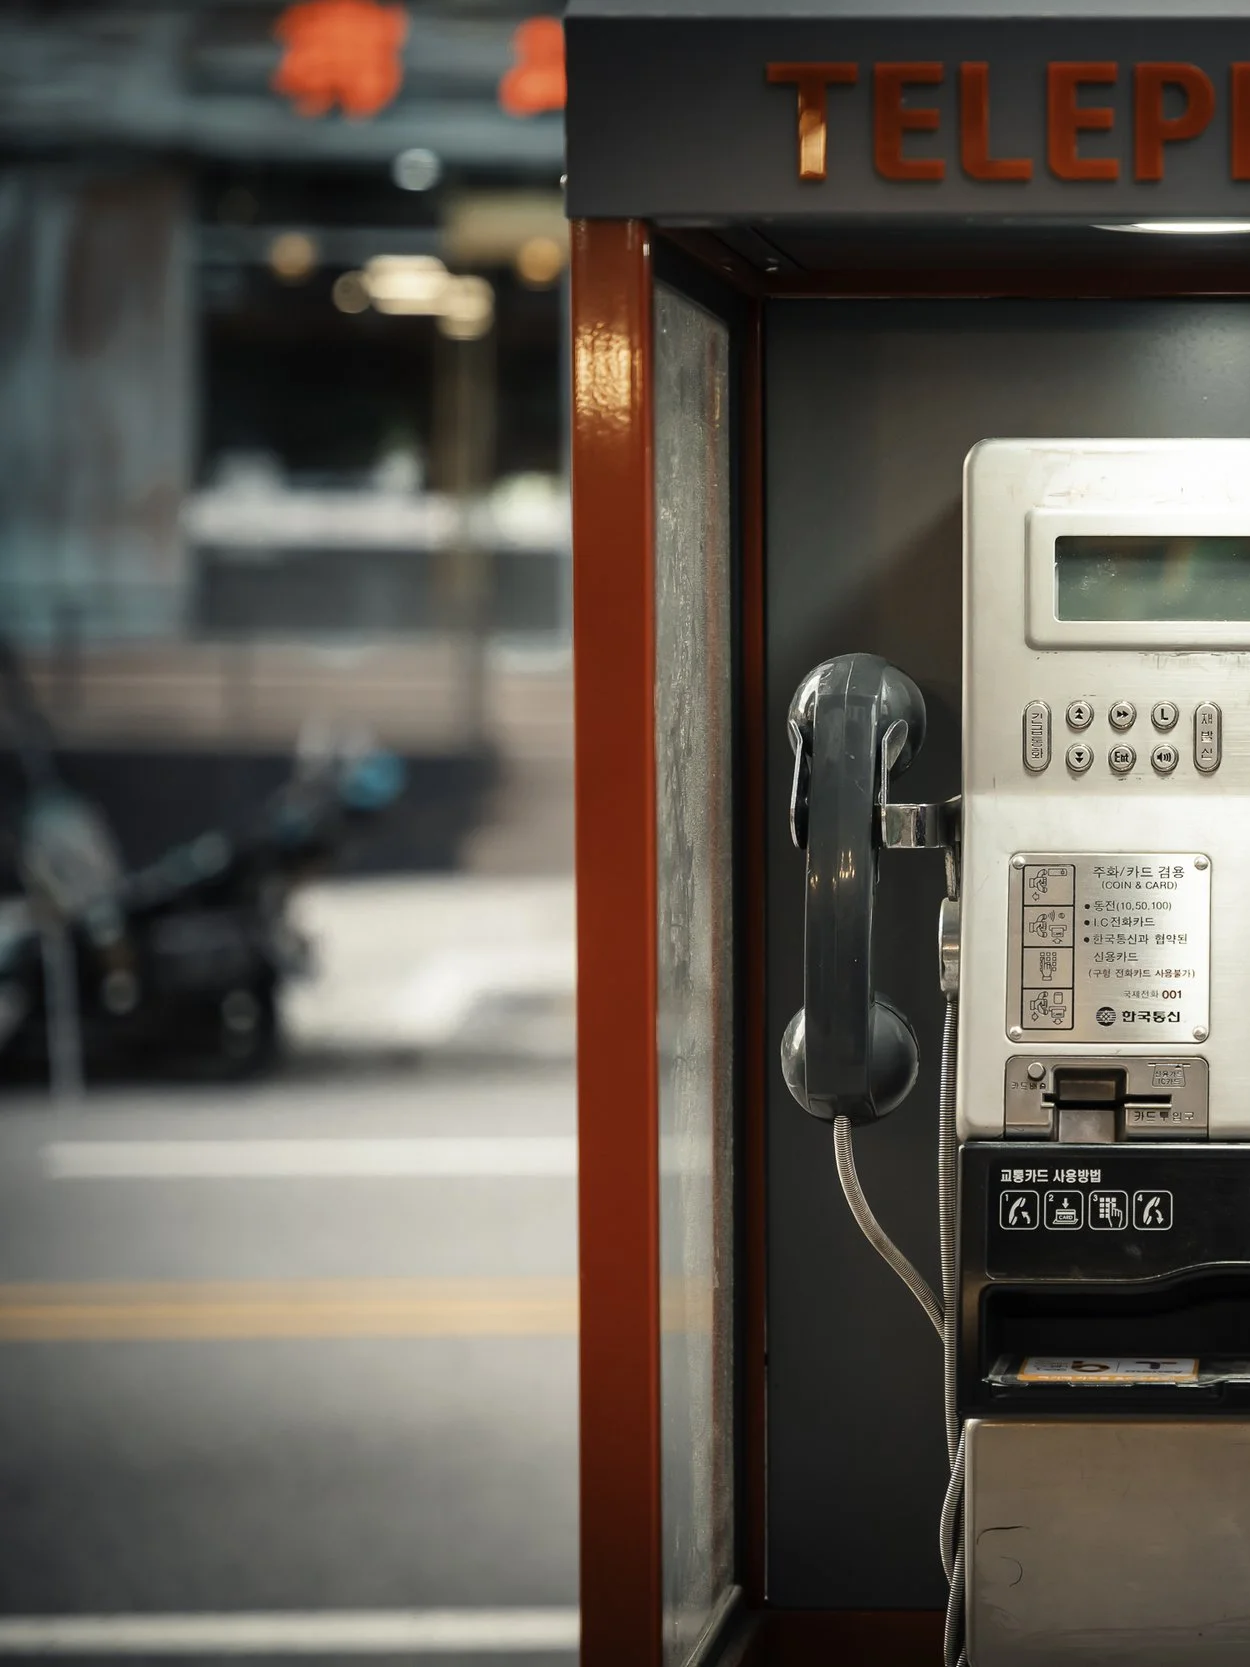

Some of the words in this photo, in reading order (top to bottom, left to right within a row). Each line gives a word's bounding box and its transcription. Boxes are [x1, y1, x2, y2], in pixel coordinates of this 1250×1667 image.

[1160, 708, 1168, 720] L
[1201, 712, 1213, 761] 재발신
[1093, 865, 1153, 879] 주화/카드
[1158, 865, 1185, 879] 겸용
[1101, 881, 1132, 891] (COIN
[1135, 881, 1142, 890] &
[1145, 881, 1178, 891] CARD)
[1093, 934, 1149, 945] 한국통신과
[1155, 934, 1187, 945] 협약된
[1093, 951, 1139, 963] 신용카드
[1088, 968, 1111, 979] (구형
[1115, 968, 1152, 979] 전화카드
[1155, 968, 1196, 979] 사용불가)
[1123, 990, 1159, 999] 국제전화
[1162, 990, 1182, 999] 001
[1121, 1010, 1181, 1023] 한국통신
[1000, 1169, 1048, 1183] 교통카드
[1053, 1169, 1101, 1183] 사용방법
[1005, 1194, 1009, 1202] 1
[1048, 1194, 1054, 1202] 2
[1092, 1194, 1098, 1202] 3
[1137, 1194, 1143, 1202] 4
